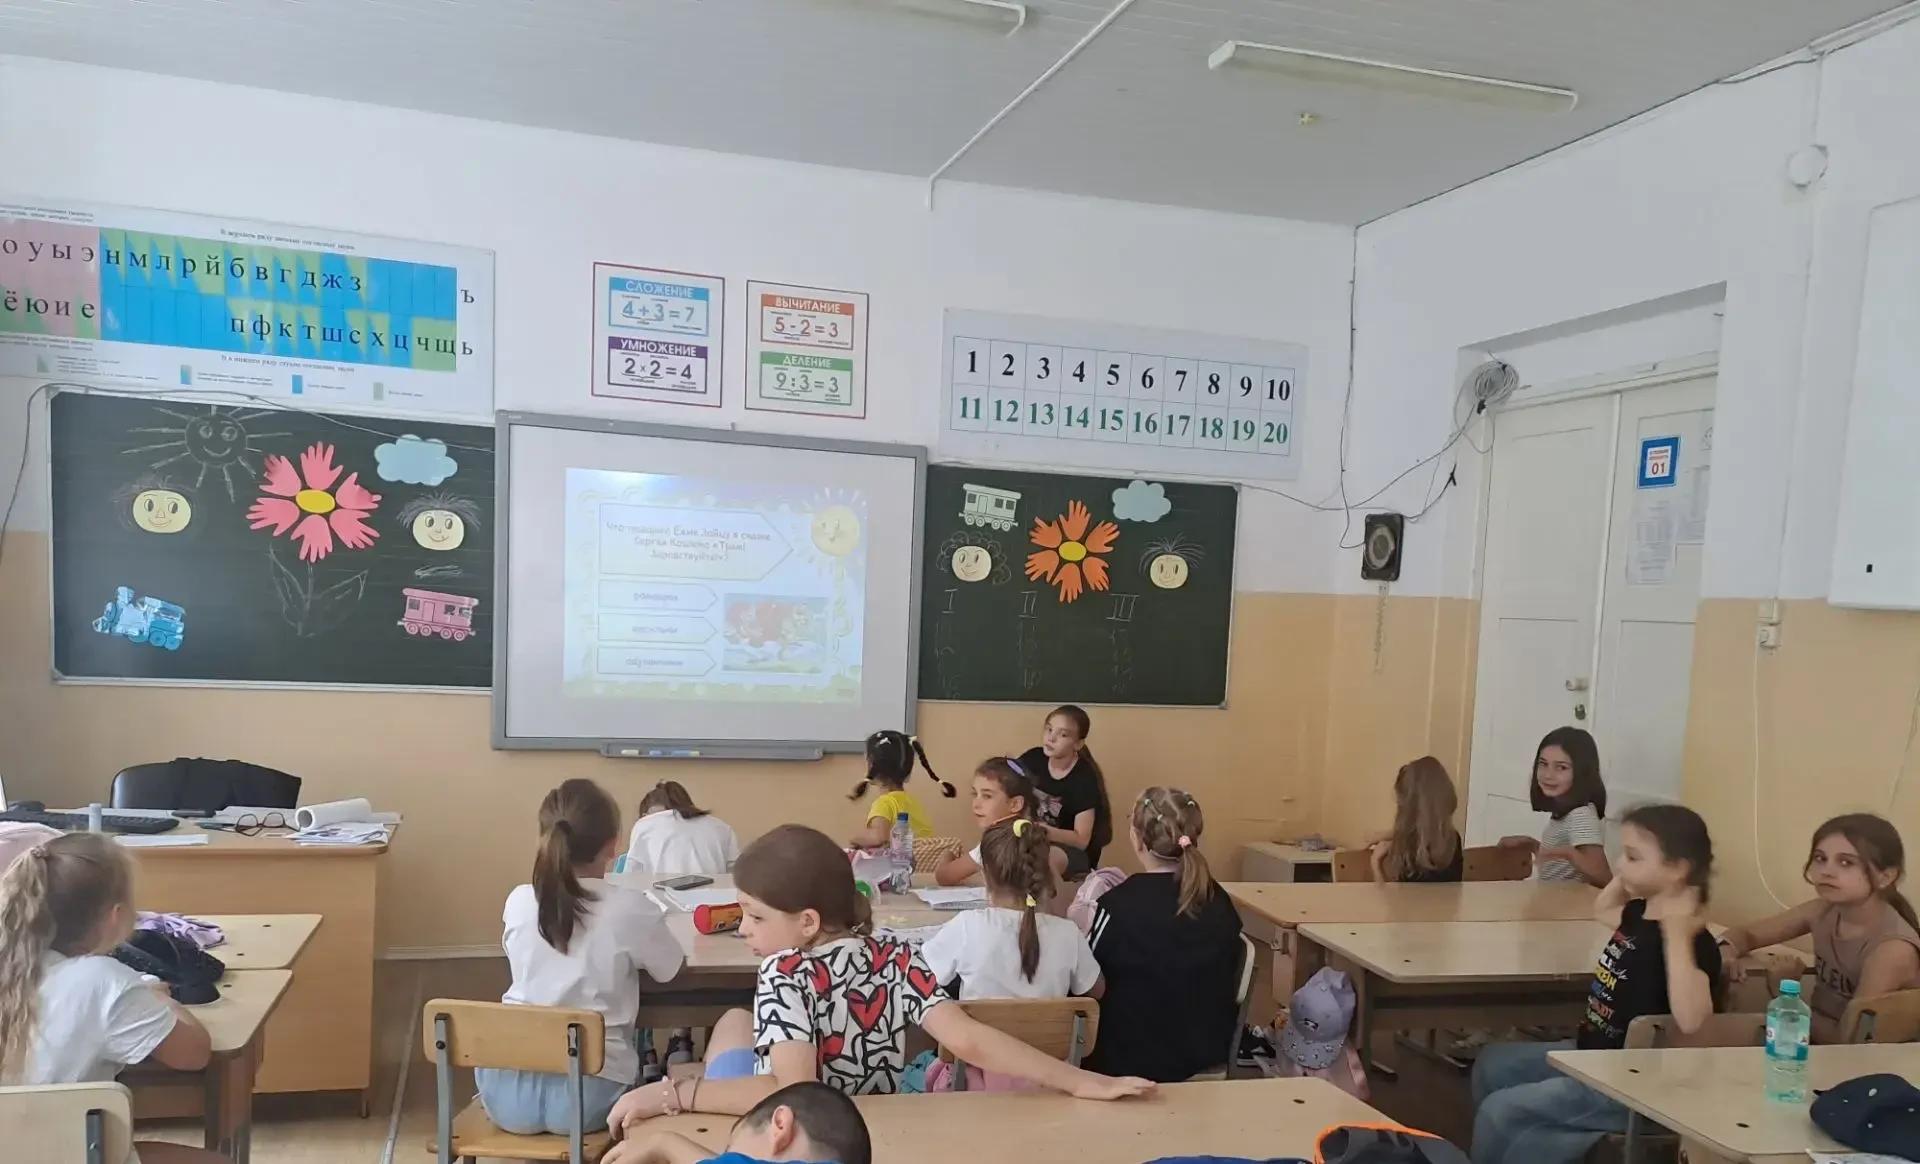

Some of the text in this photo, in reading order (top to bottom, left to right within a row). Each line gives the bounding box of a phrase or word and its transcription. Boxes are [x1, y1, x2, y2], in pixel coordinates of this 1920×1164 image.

[3, 239, 475, 303] о у ы э н м л р й б в г д ж з ъ
[625, 280, 694, 298] СЛОЖЕНИЕ
[775, 297, 841, 314] ВЫЧИТАНИЕ
[4, 290, 473, 356] ё ю и е п ф к т ш с х ц ч щ ь
[620, 339, 697, 357] УМНОЖЕНИЕ
[782, 355, 833, 369] ДЕЛЕНИЕ
[967, 350, 1290, 401] 1 2 3 4 5 6 7 8 9 10
[959, 397, 1288, 445] 11 12 13 14 15 16 17 18 19 20
[1651, 462, 1666, 475] 01
[942, 588, 1140, 622] I II III
